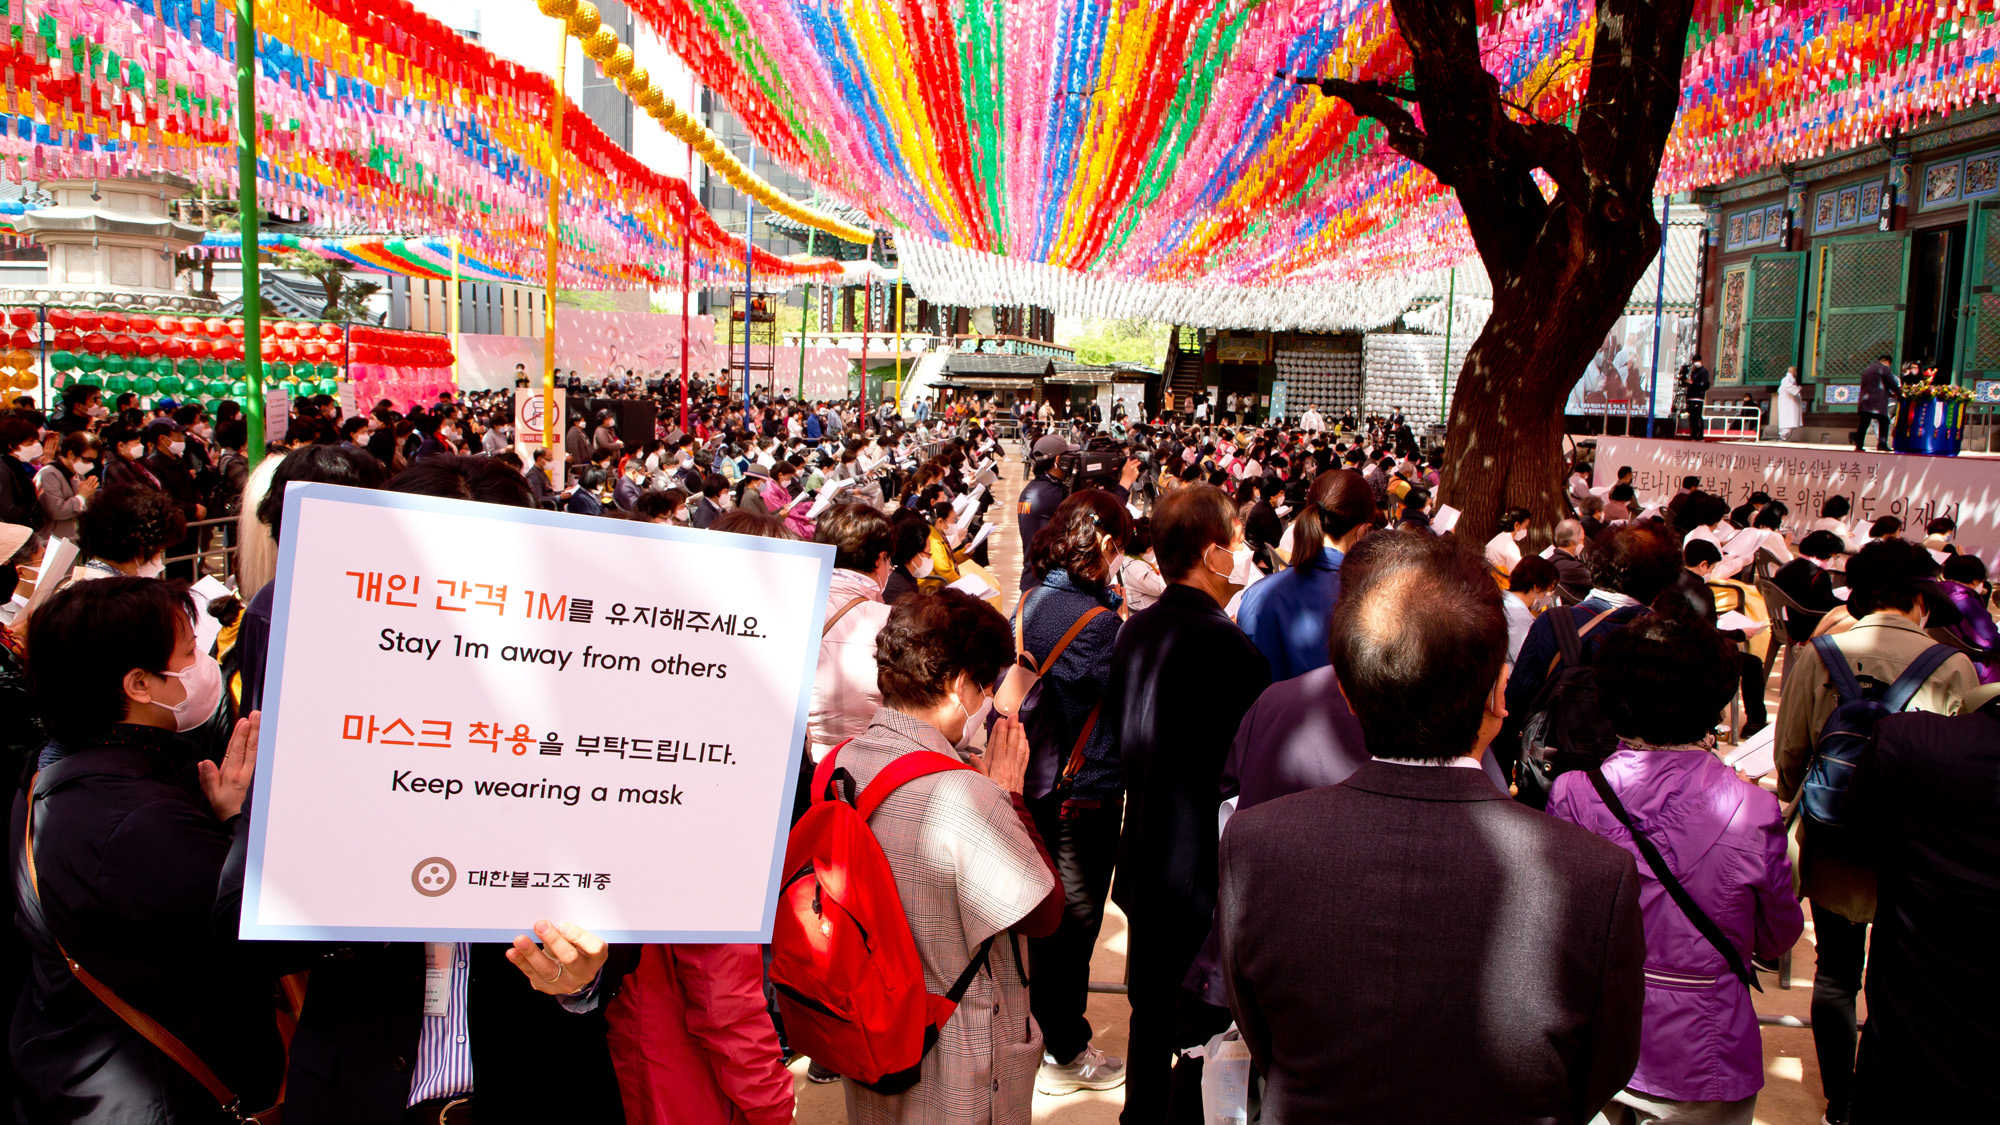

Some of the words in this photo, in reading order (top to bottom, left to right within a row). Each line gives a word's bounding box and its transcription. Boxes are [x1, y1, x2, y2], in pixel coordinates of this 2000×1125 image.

[1674, 449, 1760, 473] 불기2564(2020)년
[1766, 456, 1832, 480] 부처님오신날
[1838, 461, 1862, 482] 봉축
[1867, 463, 1880, 485] 및
[1794, 488, 1826, 518] 위한
[346, 571, 420, 608] 개인
[436, 579, 508, 616] 간격
[524, 590, 594, 624] 1M를
[605, 602, 767, 639] 유지해주세요.
[378, 628, 442, 661] Stay
[453, 634, 490, 660] 1m
[500, 645, 573, 672] away
[582, 645, 641, 672] from
[650, 653, 728, 680] others
[342, 714, 453, 749] 마스크
[468, 721, 564, 757] 착용을
[575, 734, 737, 766] 부탁드립니다.
[391, 769, 464, 800] Keep
[474, 777, 581, 807] wearing
[590, 786, 609, 803] a
[617, 783, 684, 806] mask
[467, 869, 612, 891] 대한불교조계종
[1079, 1063, 1096, 1079] N
